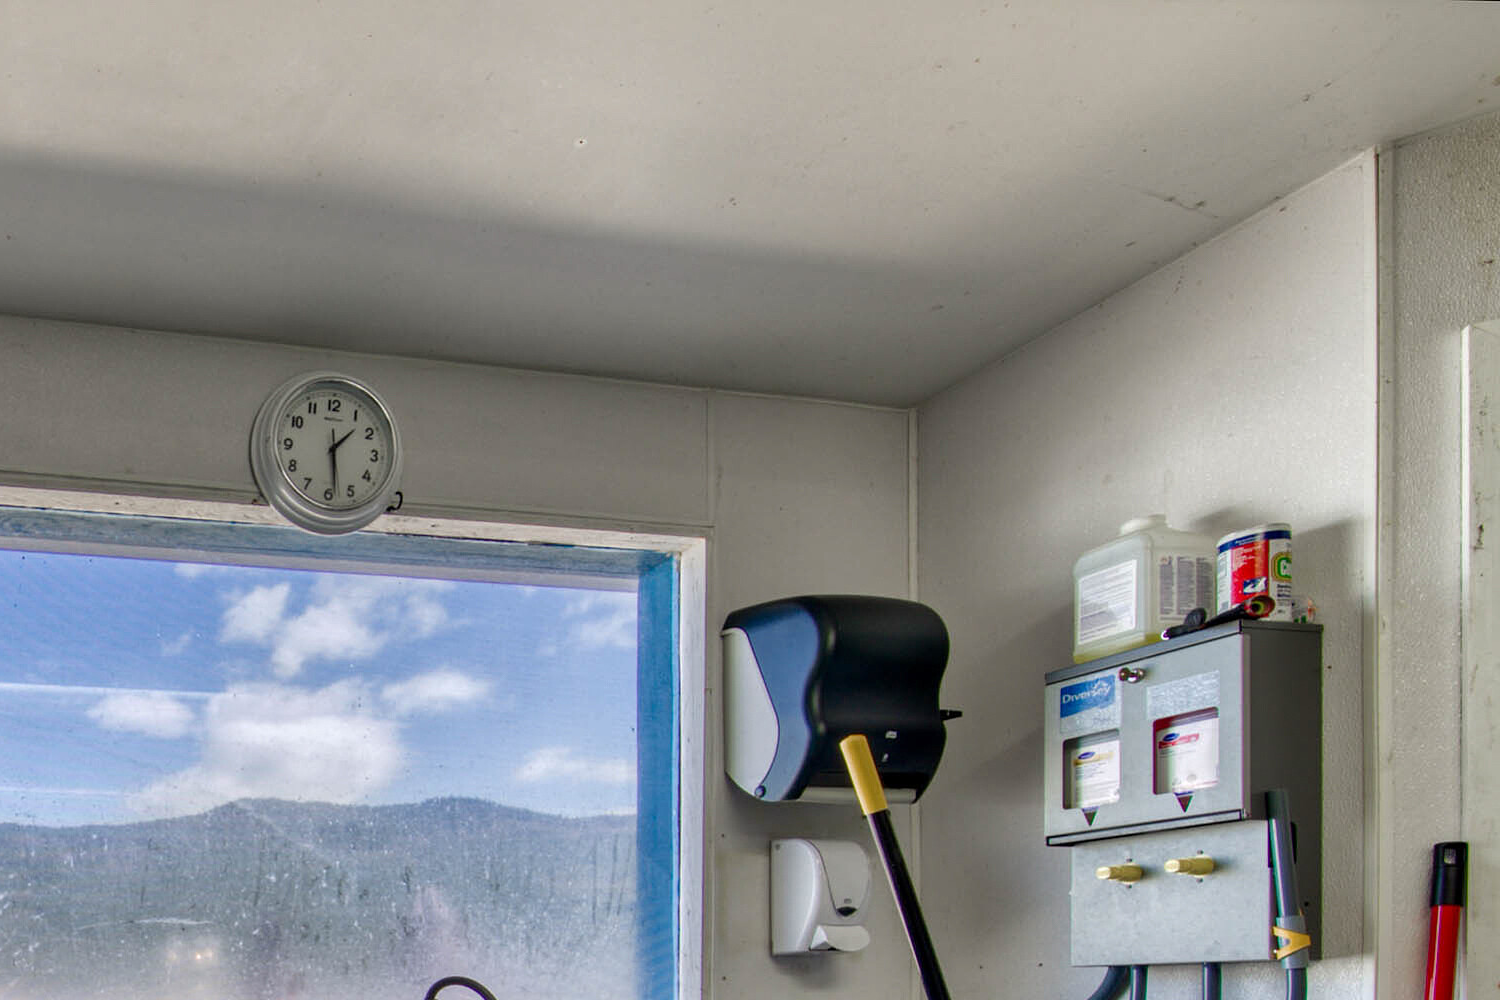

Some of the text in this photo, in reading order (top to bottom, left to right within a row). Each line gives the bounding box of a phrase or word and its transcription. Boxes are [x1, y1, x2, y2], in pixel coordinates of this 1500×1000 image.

[308, 402, 317, 414] 11
[328, 399, 341, 412] 12
[291, 416, 303, 428] 10
[365, 427, 374, 440] 2
[283, 438, 293, 450] 9
[370, 450, 378, 462] 3
[288, 459, 297, 472] 8
[362, 469, 371, 482] 4
[304, 477, 312, 490] 7
[323, 488, 333, 500] 6
[347, 485, 355, 497] 5
